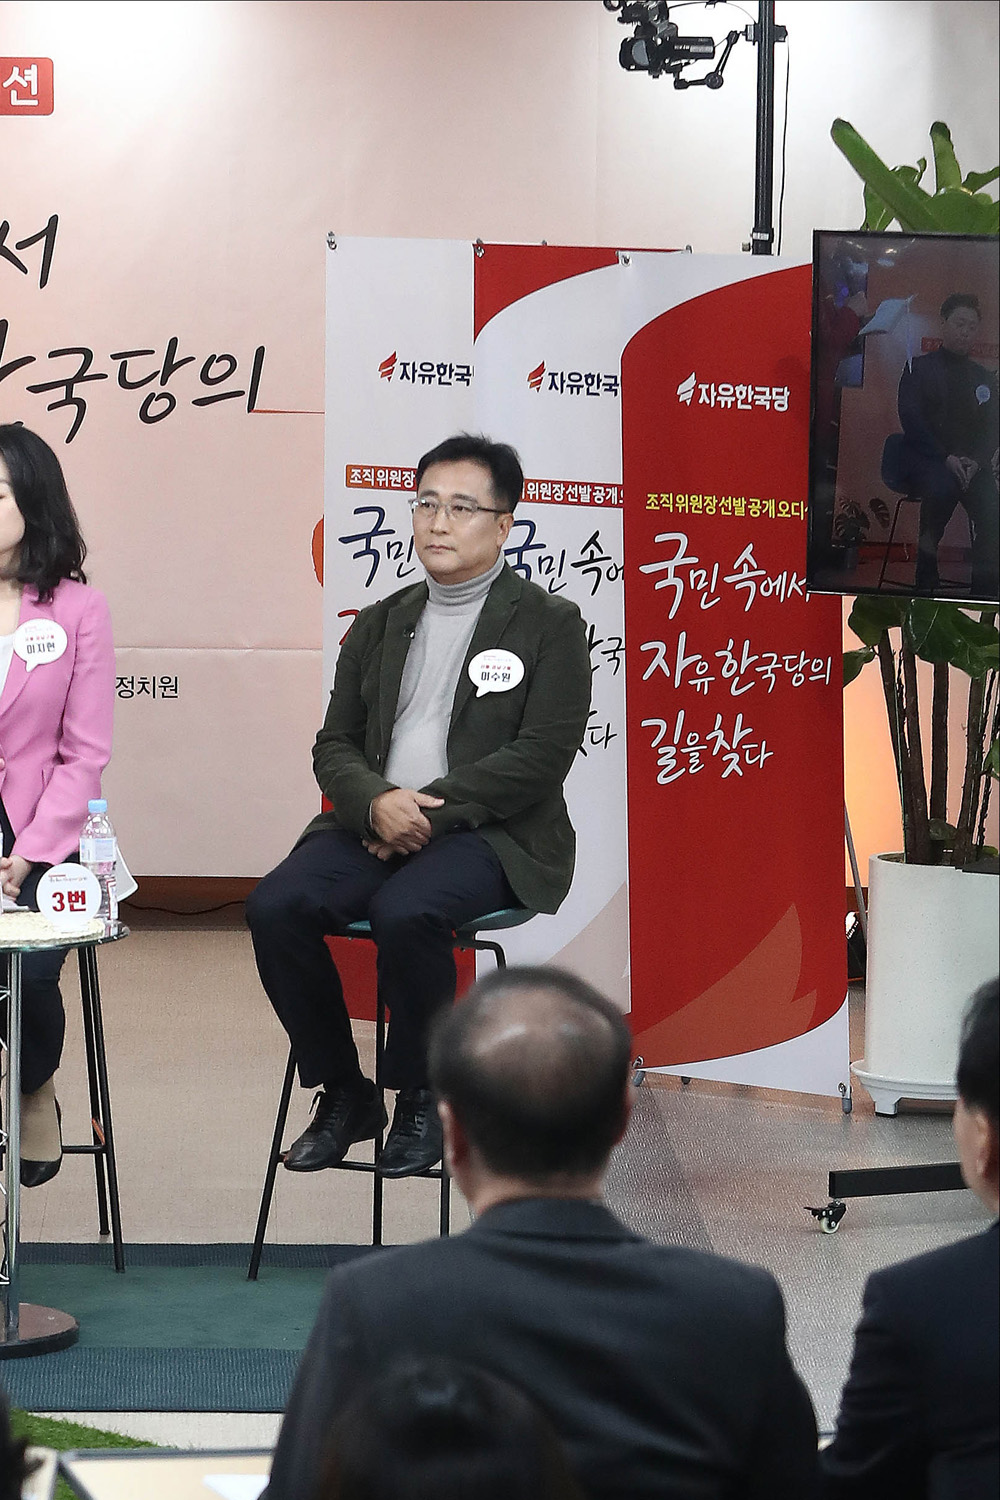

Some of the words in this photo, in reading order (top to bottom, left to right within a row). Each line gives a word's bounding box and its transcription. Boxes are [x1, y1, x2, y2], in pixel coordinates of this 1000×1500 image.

[400, 361, 475, 387] 자유한국
[698, 383, 790, 412] 자유한국당
[566, 484, 591, 503] 선발
[593, 486, 618, 505] 공개
[719, 496, 747, 517] 선발
[748, 498, 775, 518] 공개
[777, 500, 808, 521] 오디
[338, 506, 416, 588] 국민
[504, 519, 568, 594] 국민
[571, 530, 624, 596] 속에
[639, 532, 721, 620] 국민
[723, 542, 809, 612] 속에서
[480, 671, 511, 682] 이수원
[640, 631, 832, 697] 자유한국당의
[115, 675, 179, 699] 정치원
[641, 709, 708, 785] 길을
[706, 713, 774, 779] 찾다
[52, 890, 87, 912] 3번
